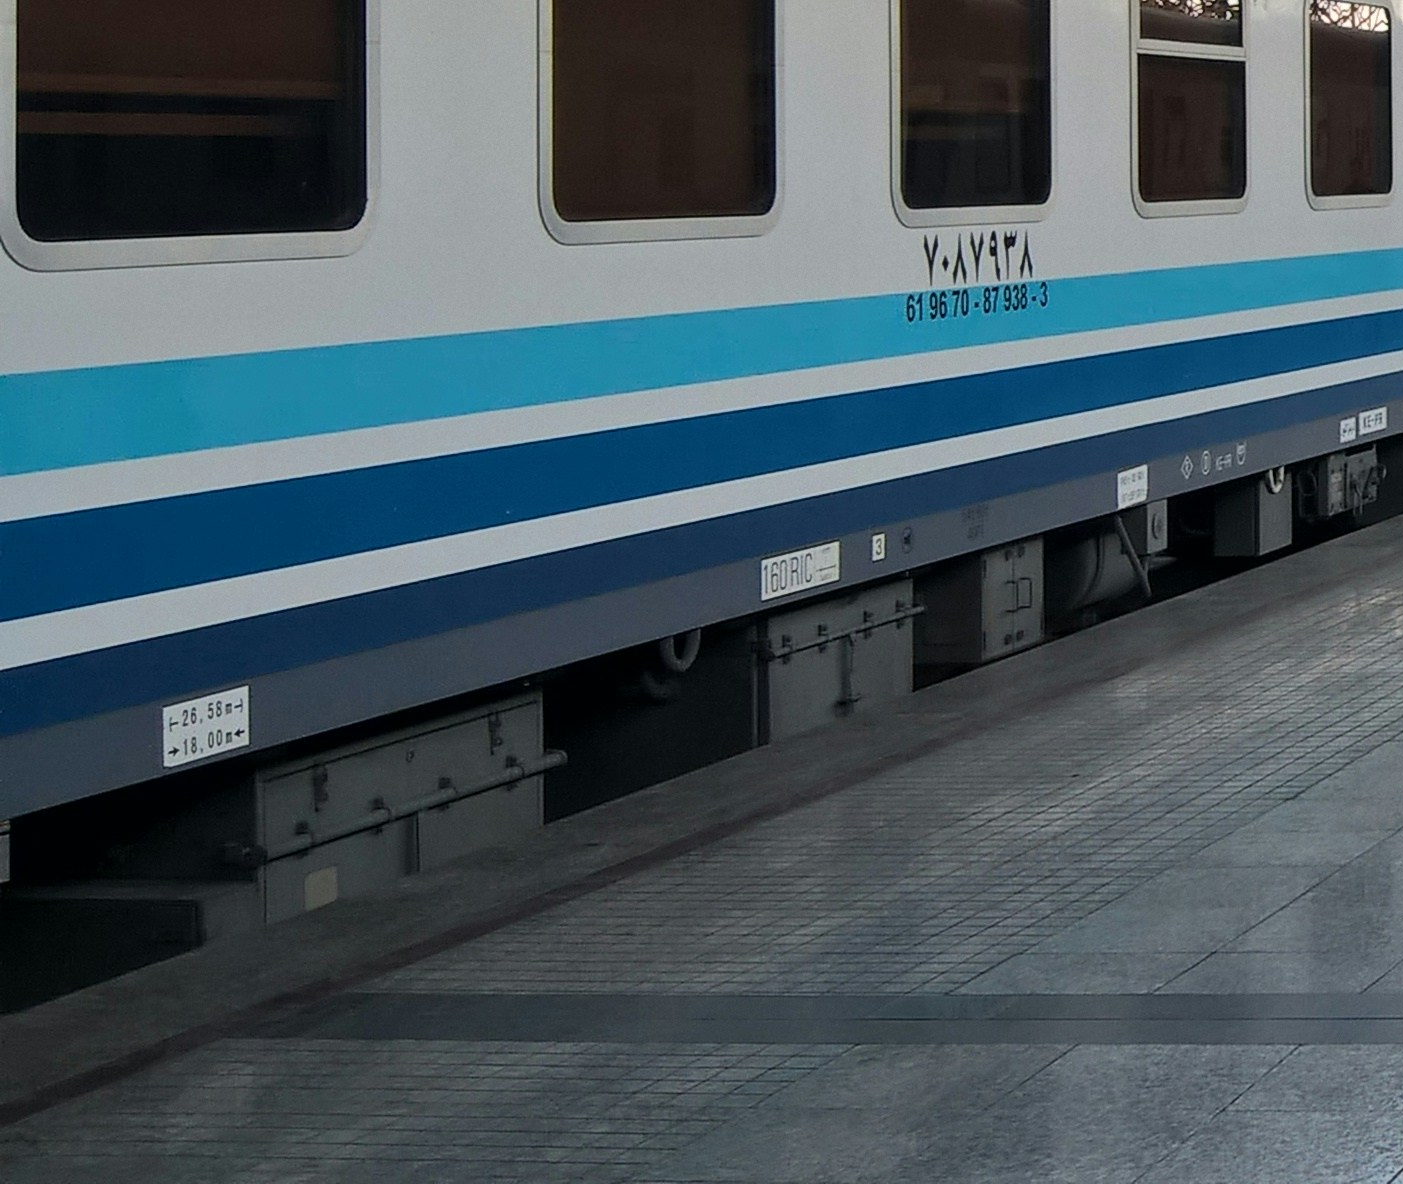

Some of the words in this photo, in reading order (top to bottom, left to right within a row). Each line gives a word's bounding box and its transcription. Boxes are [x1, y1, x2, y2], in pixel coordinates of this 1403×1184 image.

[923, 230, 1033, 287] ۷۰۸۷۹۳۸
[906, 293, 924, 323] 61
[929, 290, 948, 320] 96
[952, 288, 969, 317] 70
[983, 285, 1000, 315] 87
[1004, 283, 1028, 312] 938
[1039, 280, 1049, 308] 3
[875, 538, 883, 556] 3
